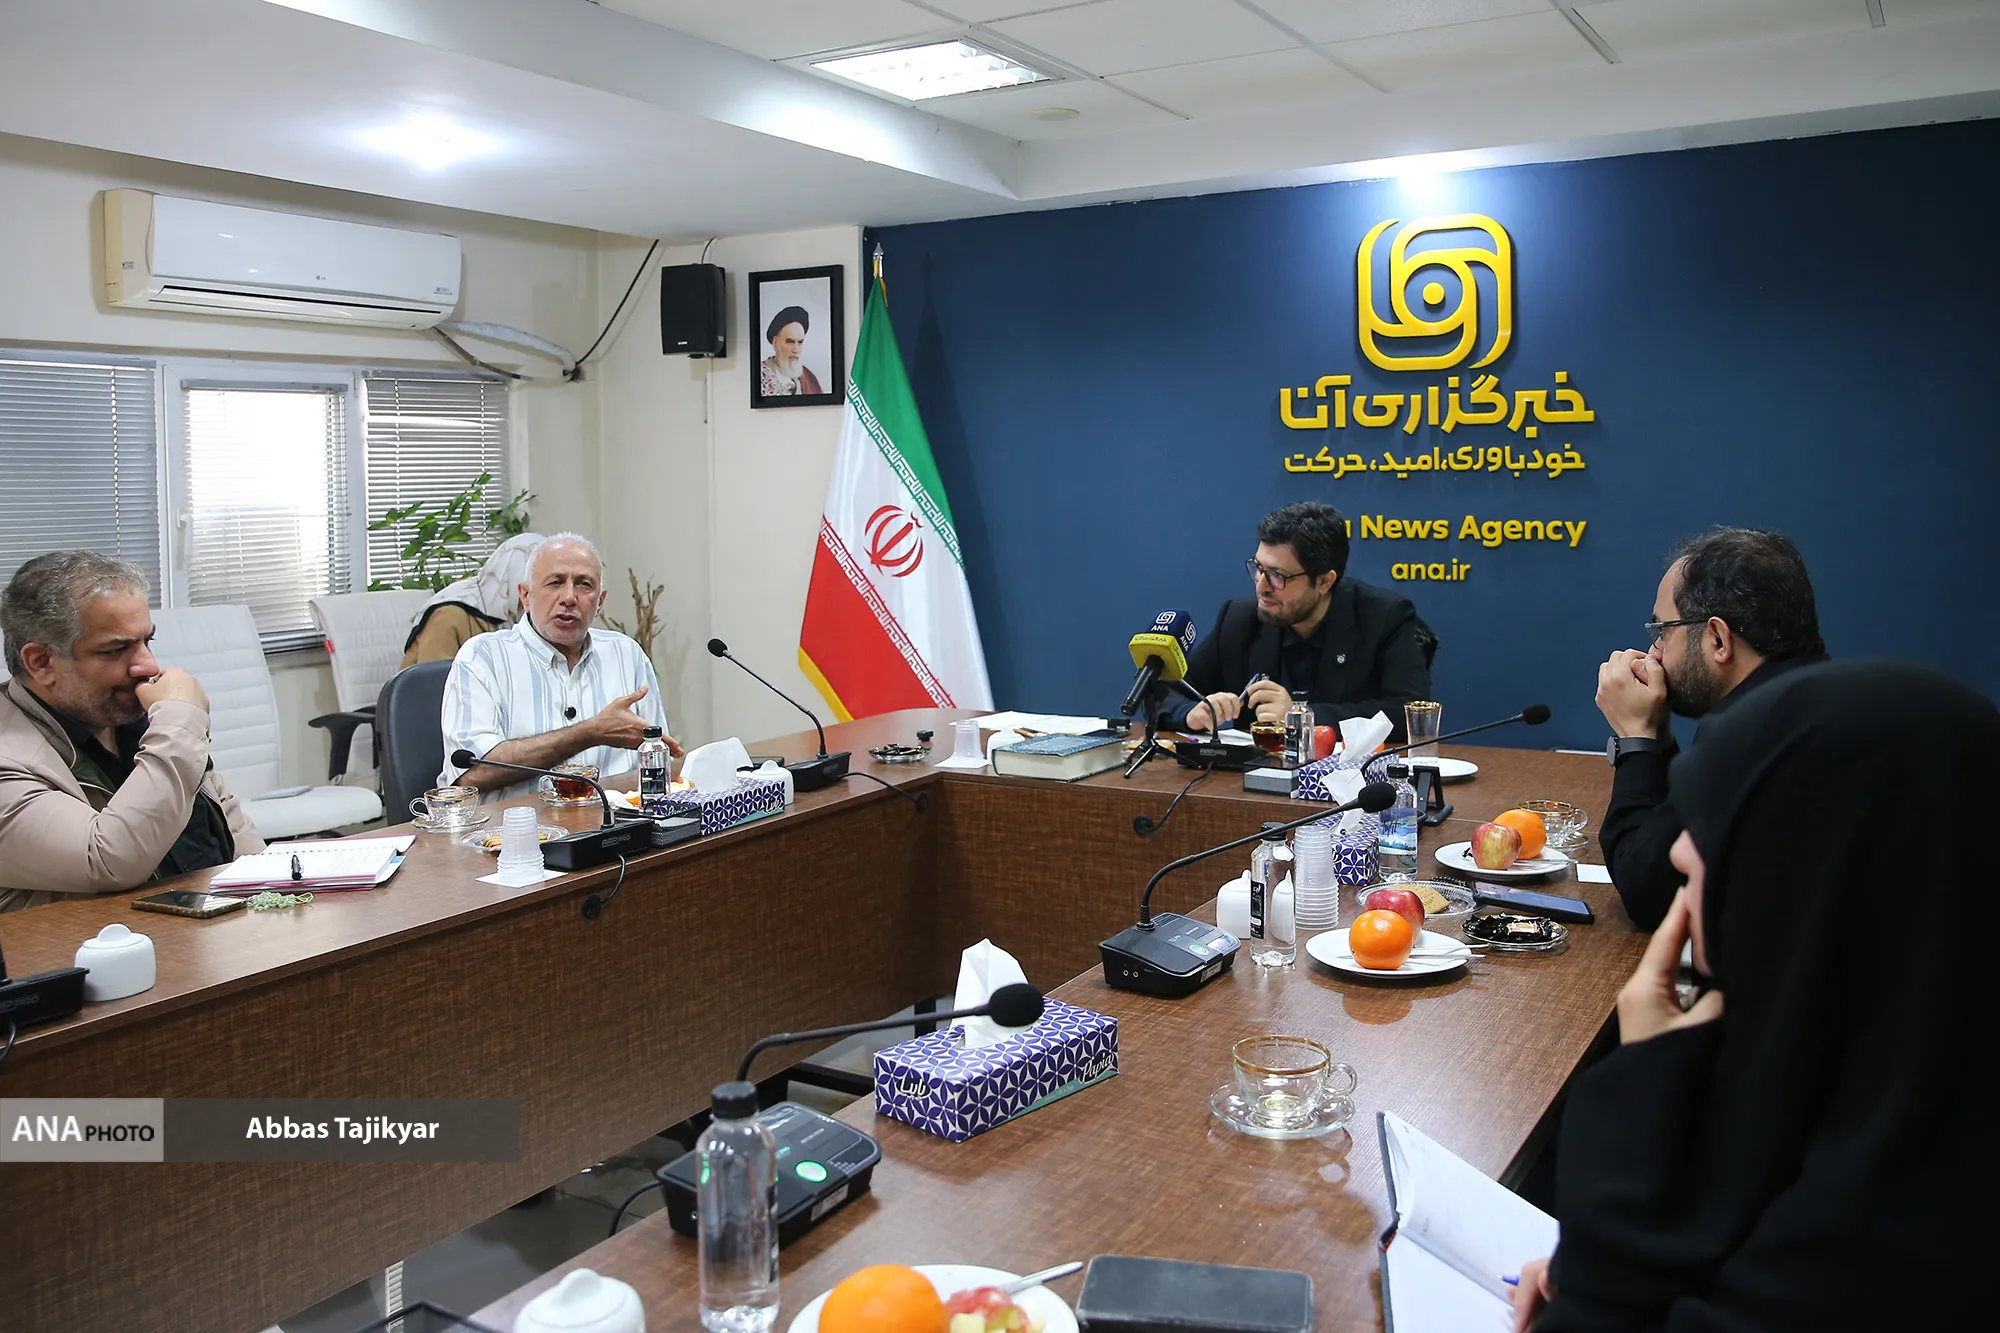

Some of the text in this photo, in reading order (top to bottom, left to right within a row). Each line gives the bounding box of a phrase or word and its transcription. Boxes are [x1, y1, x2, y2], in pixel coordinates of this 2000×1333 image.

[1279, 371, 1595, 438] خبرگزاری آنا
[1360, 514, 1449, 540] News
[1458, 514, 1587, 547] Agency
[1391, 558, 1471, 581] ana.ir
[1150, 624, 1169, 632] ANA
[1082, 1052, 1114, 1084] Papia
